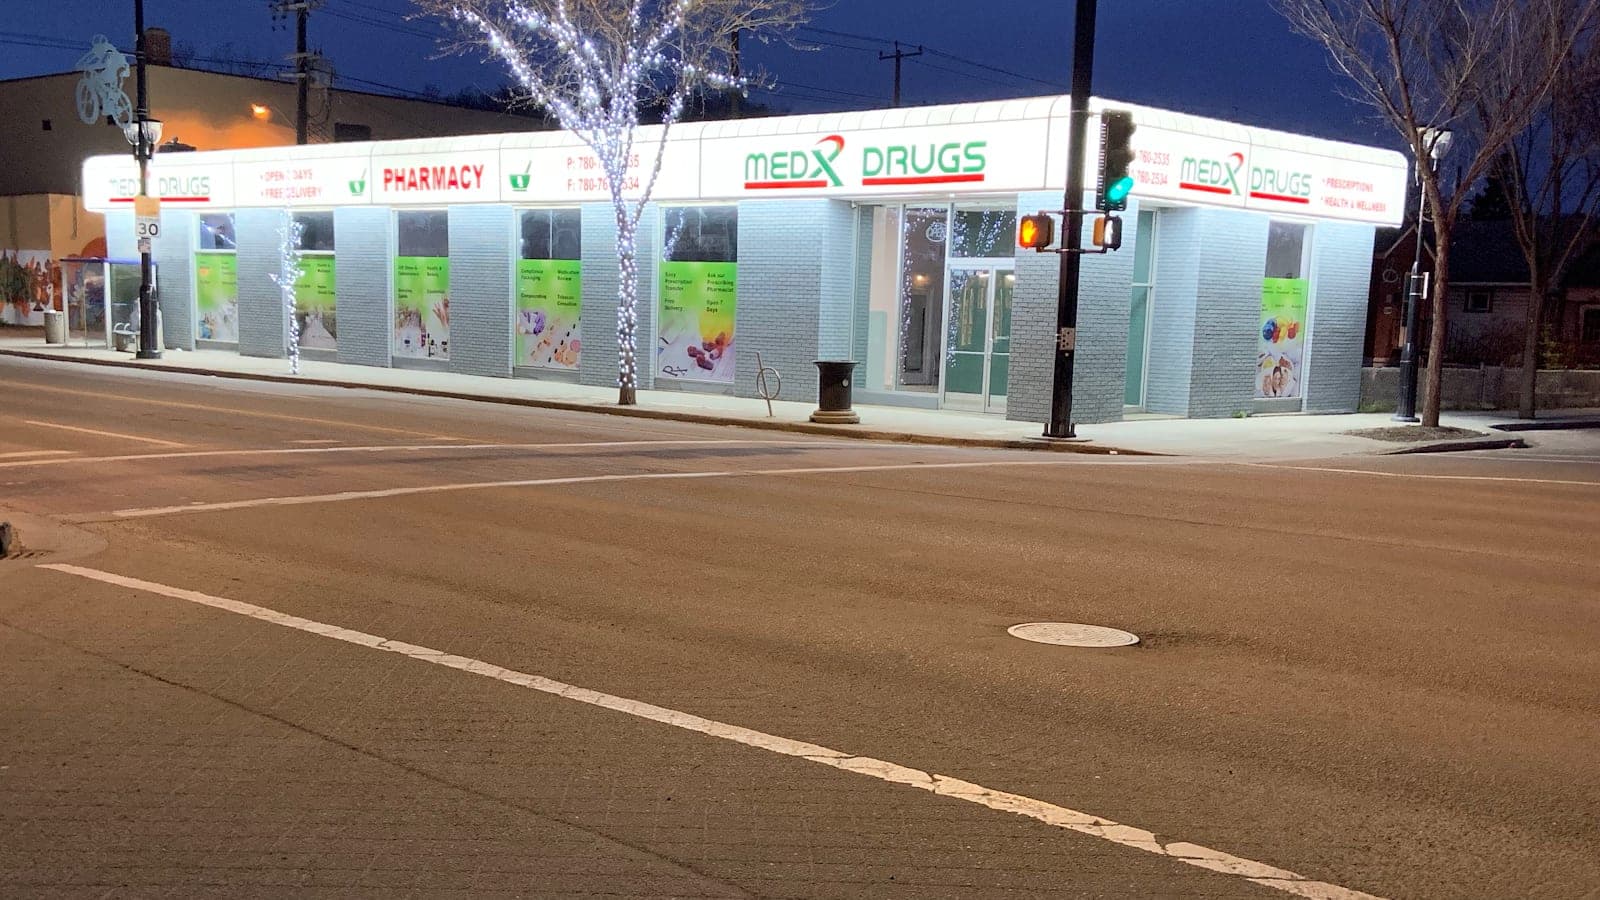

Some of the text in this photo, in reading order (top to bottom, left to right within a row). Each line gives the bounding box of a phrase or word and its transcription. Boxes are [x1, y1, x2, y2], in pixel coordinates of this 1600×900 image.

[745, 134, 987, 187] MEDX DRUGS
[1180, 152, 1313, 196] MEDX DRUGS
[158, 176, 211, 196] DRUGS
[383, 164, 484, 192] PHARMACY
[138, 222, 159, 236] 30
